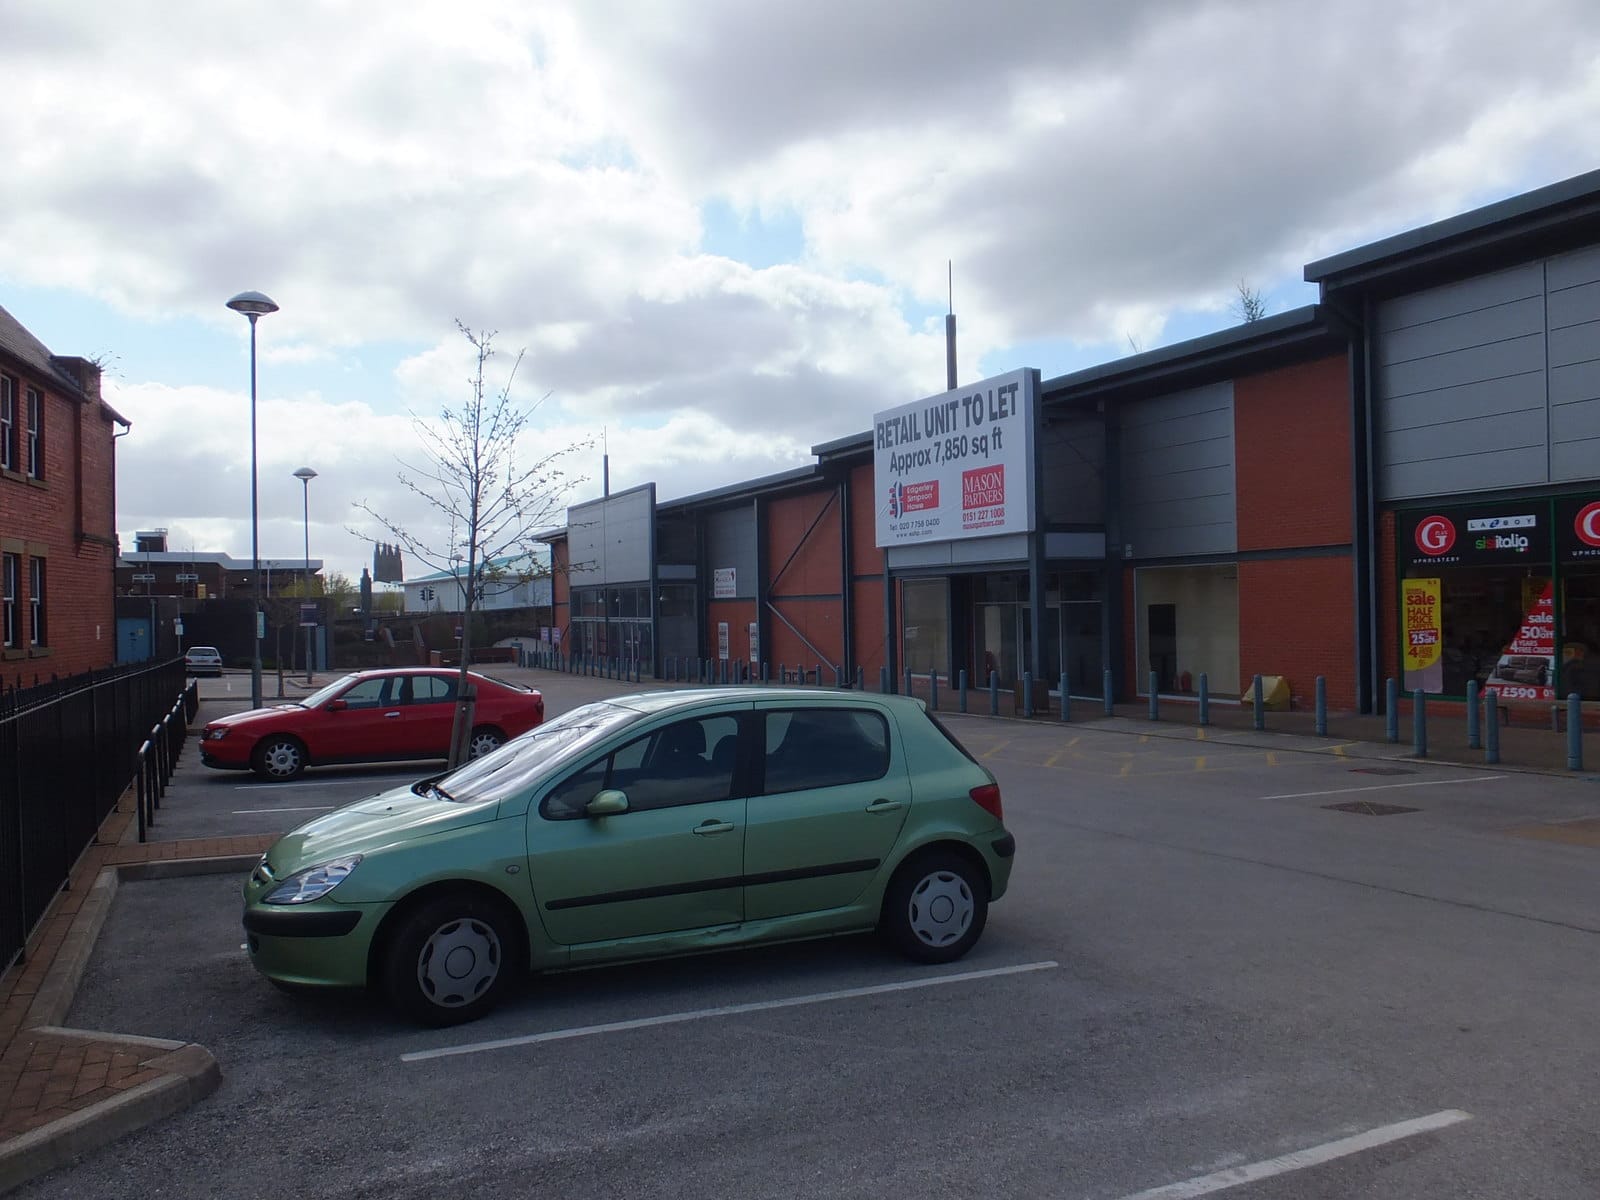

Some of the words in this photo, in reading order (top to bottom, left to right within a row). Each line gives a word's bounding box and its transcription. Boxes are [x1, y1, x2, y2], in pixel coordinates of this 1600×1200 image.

[877, 412, 921, 450] RETAIL
[924, 400, 959, 438] UNIT
[963, 393, 984, 428] TO
[988, 382, 1019, 422] LET
[889, 448, 931, 476] Approx
[934, 433, 968, 466] 7,850
[972, 434, 988, 459] sq
[992, 426, 1002, 450] ft
[964, 472, 1002, 493] MASON
[906, 484, 934, 495] Edgerley
[907, 493, 933, 503] Simpson
[964, 489, 1003, 507] PARTNERS
[962, 511, 976, 522] 0151
[978, 510, 988, 521] 227
[899, 521, 910, 530] 020
[1412, 556, 1460, 564] UPHOLSTERY
[1407, 591, 1436, 605] sale
[1408, 606, 1433, 615] HALF
[1408, 615, 1433, 624] PRICE
[1528, 612, 1553, 624] sale
[1408, 646, 1418, 658] 4
[1510, 640, 1519, 653] 4
[1502, 687, 1536, 698] £590
